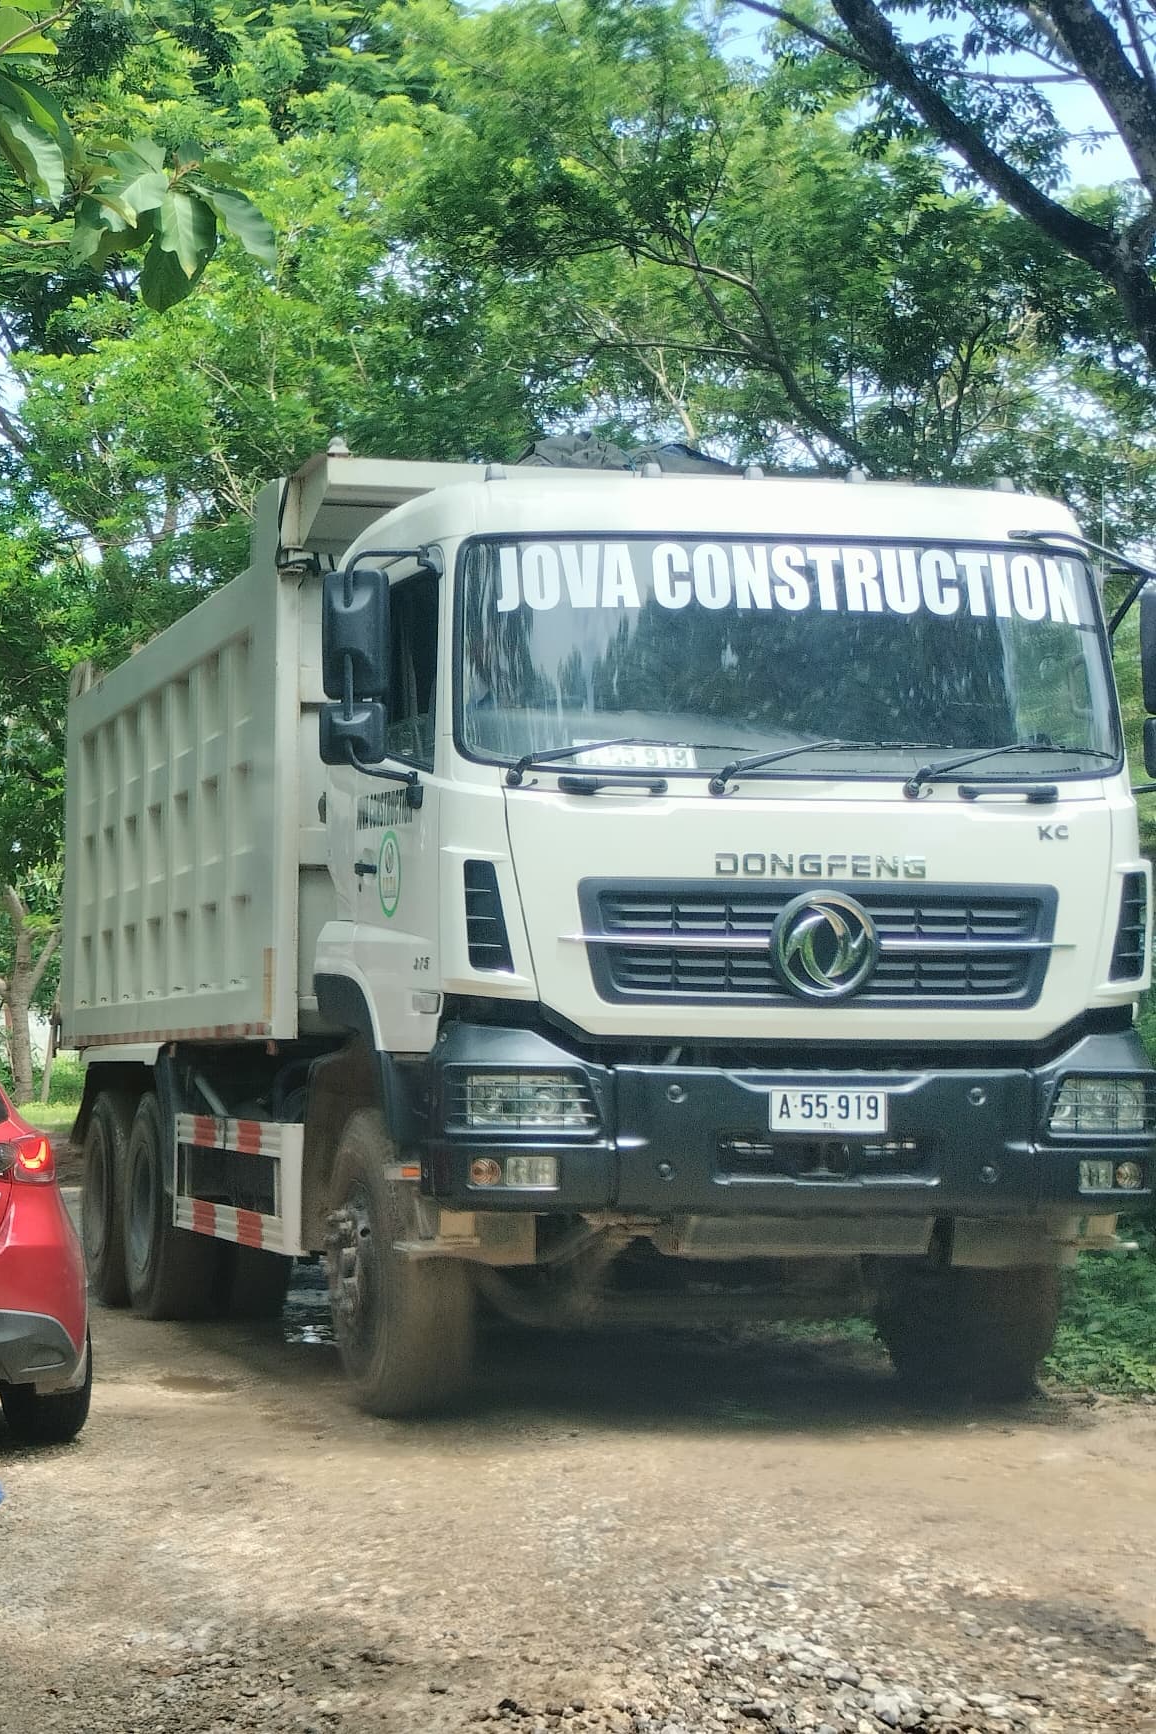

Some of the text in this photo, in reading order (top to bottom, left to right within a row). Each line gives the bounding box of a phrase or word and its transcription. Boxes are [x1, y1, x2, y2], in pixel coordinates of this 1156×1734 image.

[497, 542, 1081, 626] JOVA CONSTRUCTION
[1037, 824, 1069, 841] KC
[715, 852, 927, 879] DONGFENG
